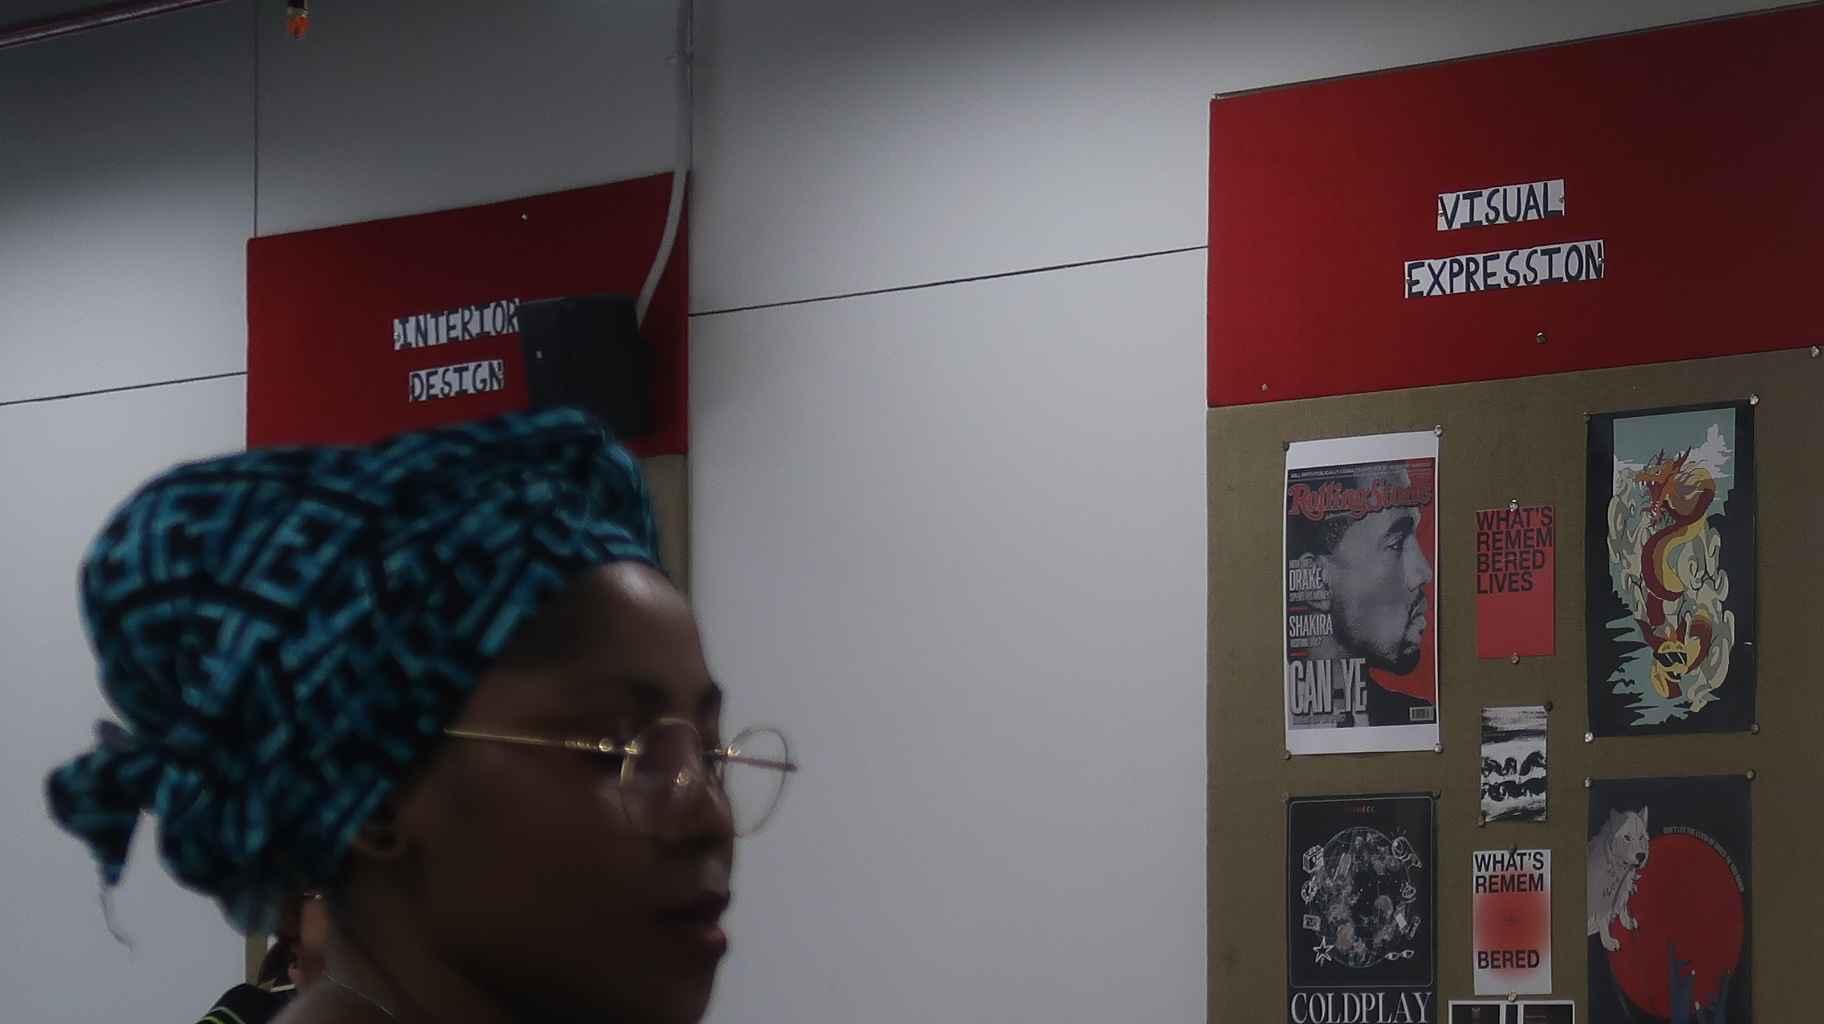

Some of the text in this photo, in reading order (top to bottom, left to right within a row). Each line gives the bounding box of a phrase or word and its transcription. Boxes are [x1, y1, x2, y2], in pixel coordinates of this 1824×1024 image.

[1439, 182, 1564, 229] VISUAL
[1406, 243, 1602, 297] EXPRESSION
[399, 299, 520, 347] INTERIOR
[411, 362, 503, 401] DESIGN
[1476, 506, 1553, 531] WHAT'S
[1477, 527, 1553, 552] REMEM
[1477, 549, 1545, 573] BERED
[1289, 567, 1322, 592] DRAKE
[1477, 571, 1534, 594] LIVES
[1289, 613, 1334, 638] SHAKIRA
[1289, 658, 1368, 714] CAN YE
[1474, 851, 1545, 873] WHAT'S
[1475, 873, 1544, 894] REMEM
[1478, 949, 1541, 970] BERED
[1290, 991, 1432, 1024] COLDPLAY
